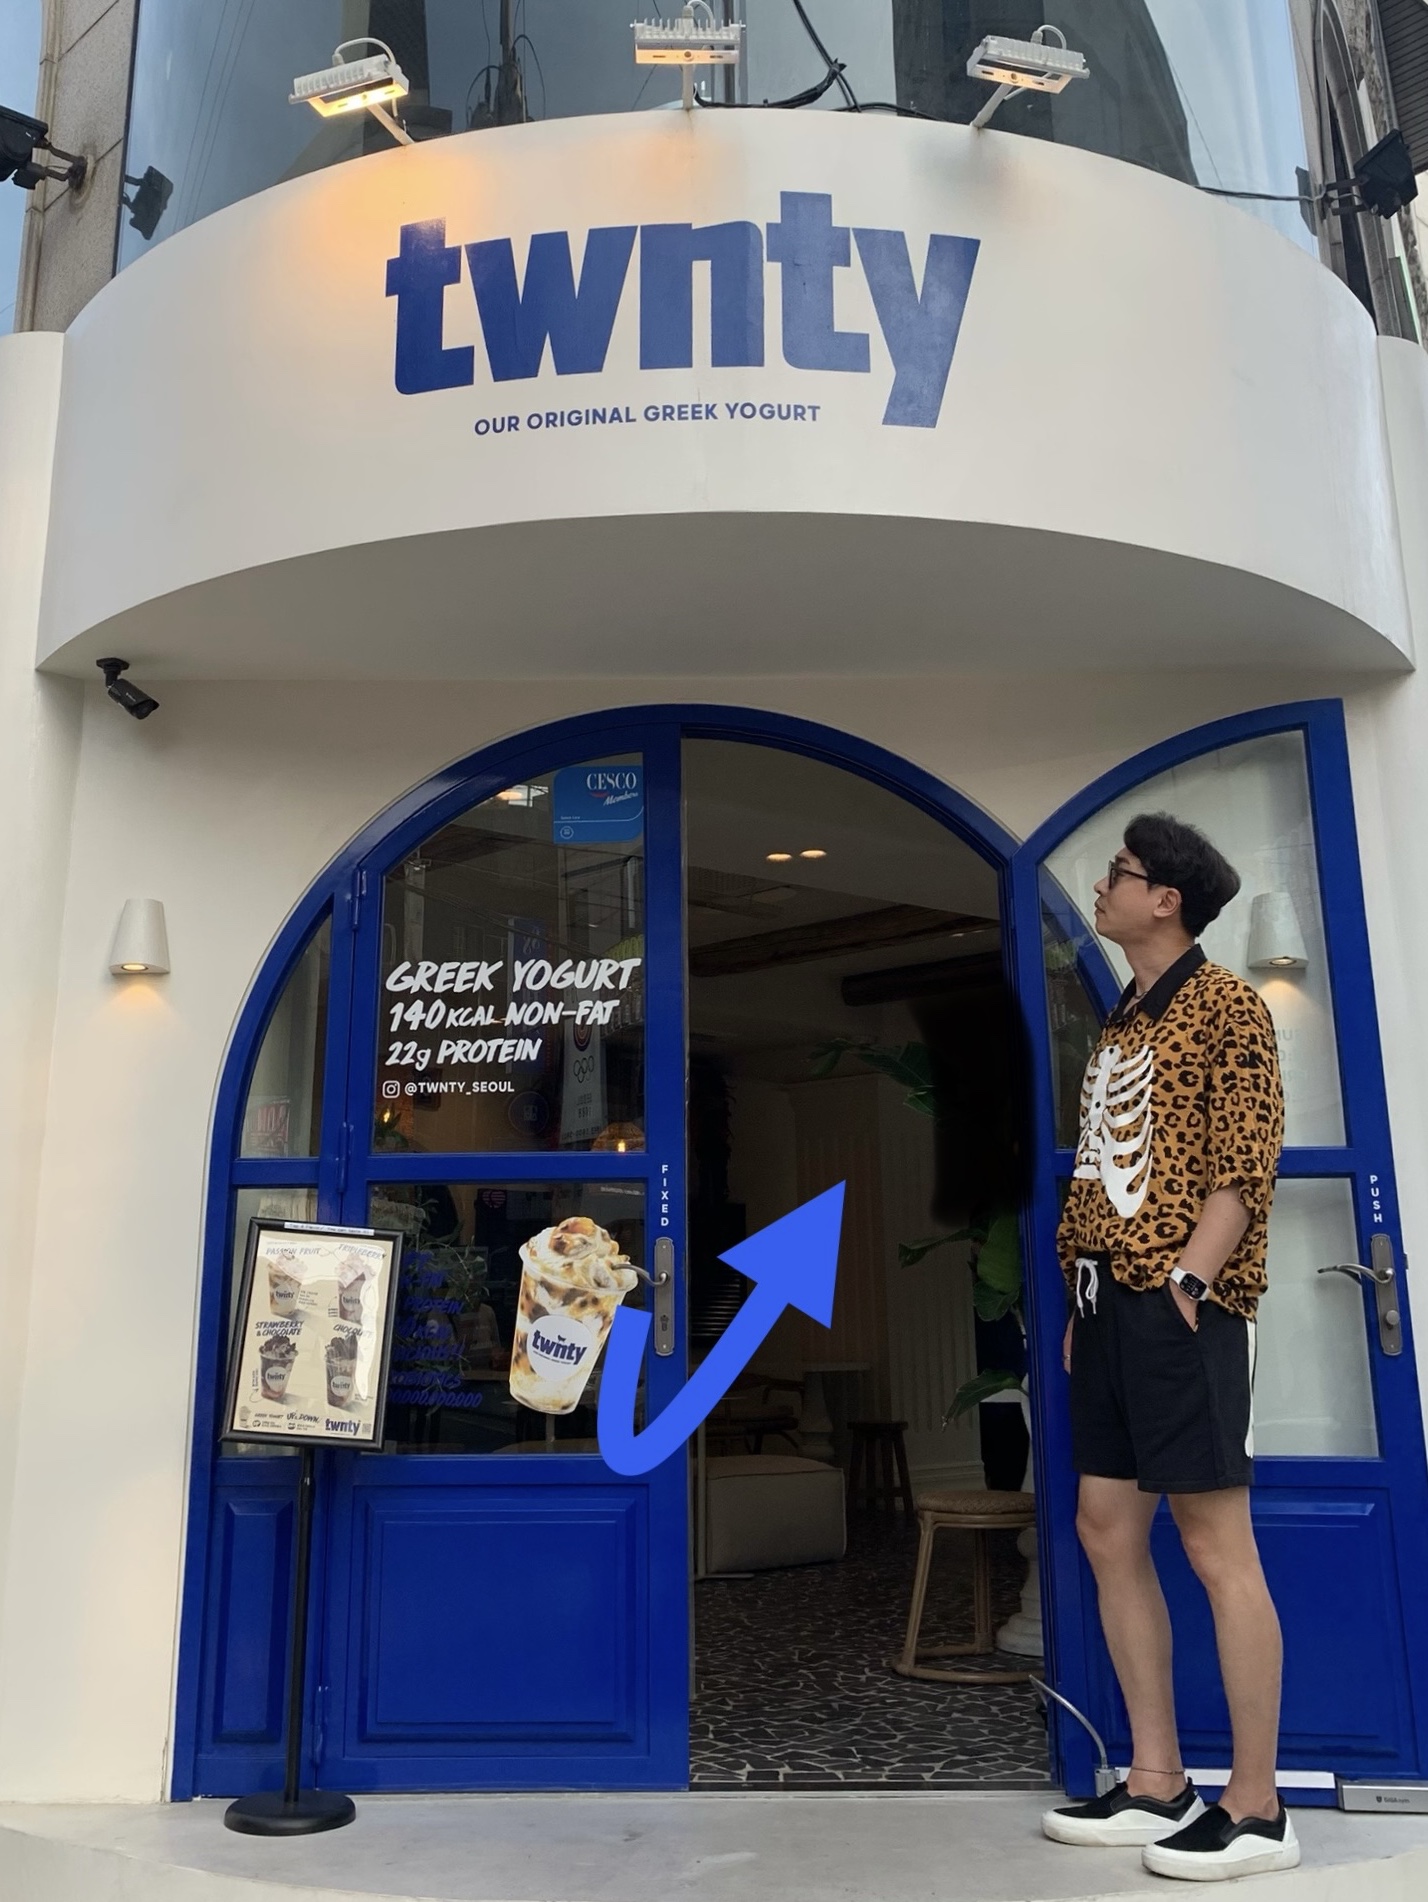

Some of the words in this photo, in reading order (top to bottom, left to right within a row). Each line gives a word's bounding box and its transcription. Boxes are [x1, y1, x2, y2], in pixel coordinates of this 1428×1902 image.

[385, 190, 981, 429] twnty
[474, 415, 520, 435] OUR
[526, 406, 637, 430] ORIGINAL
[643, 403, 719, 422] GREEK
[725, 402, 821, 421] YOGURT
[586, 772, 637, 790] CESCO
[385, 960, 503, 993] GREEK
[513, 958, 642, 992] YOGURT
[504, 999, 620, 1027] NON-FAT
[384, 1040, 432, 1071] 22g
[436, 1037, 542, 1066] PROTEIN
[404, 1081, 515, 1096] @TWNTY_SEOUL
[661, 1164, 669, 1227] FIXED
[1369, 1174, 1383, 1223] PUSH
[255, 1320, 305, 1330] STRAWBERRY
[262, 1327, 302, 1337] CHOCOLATE
[531, 1329, 588, 1365] twnty
[325, 1418, 361, 1436] twnty
